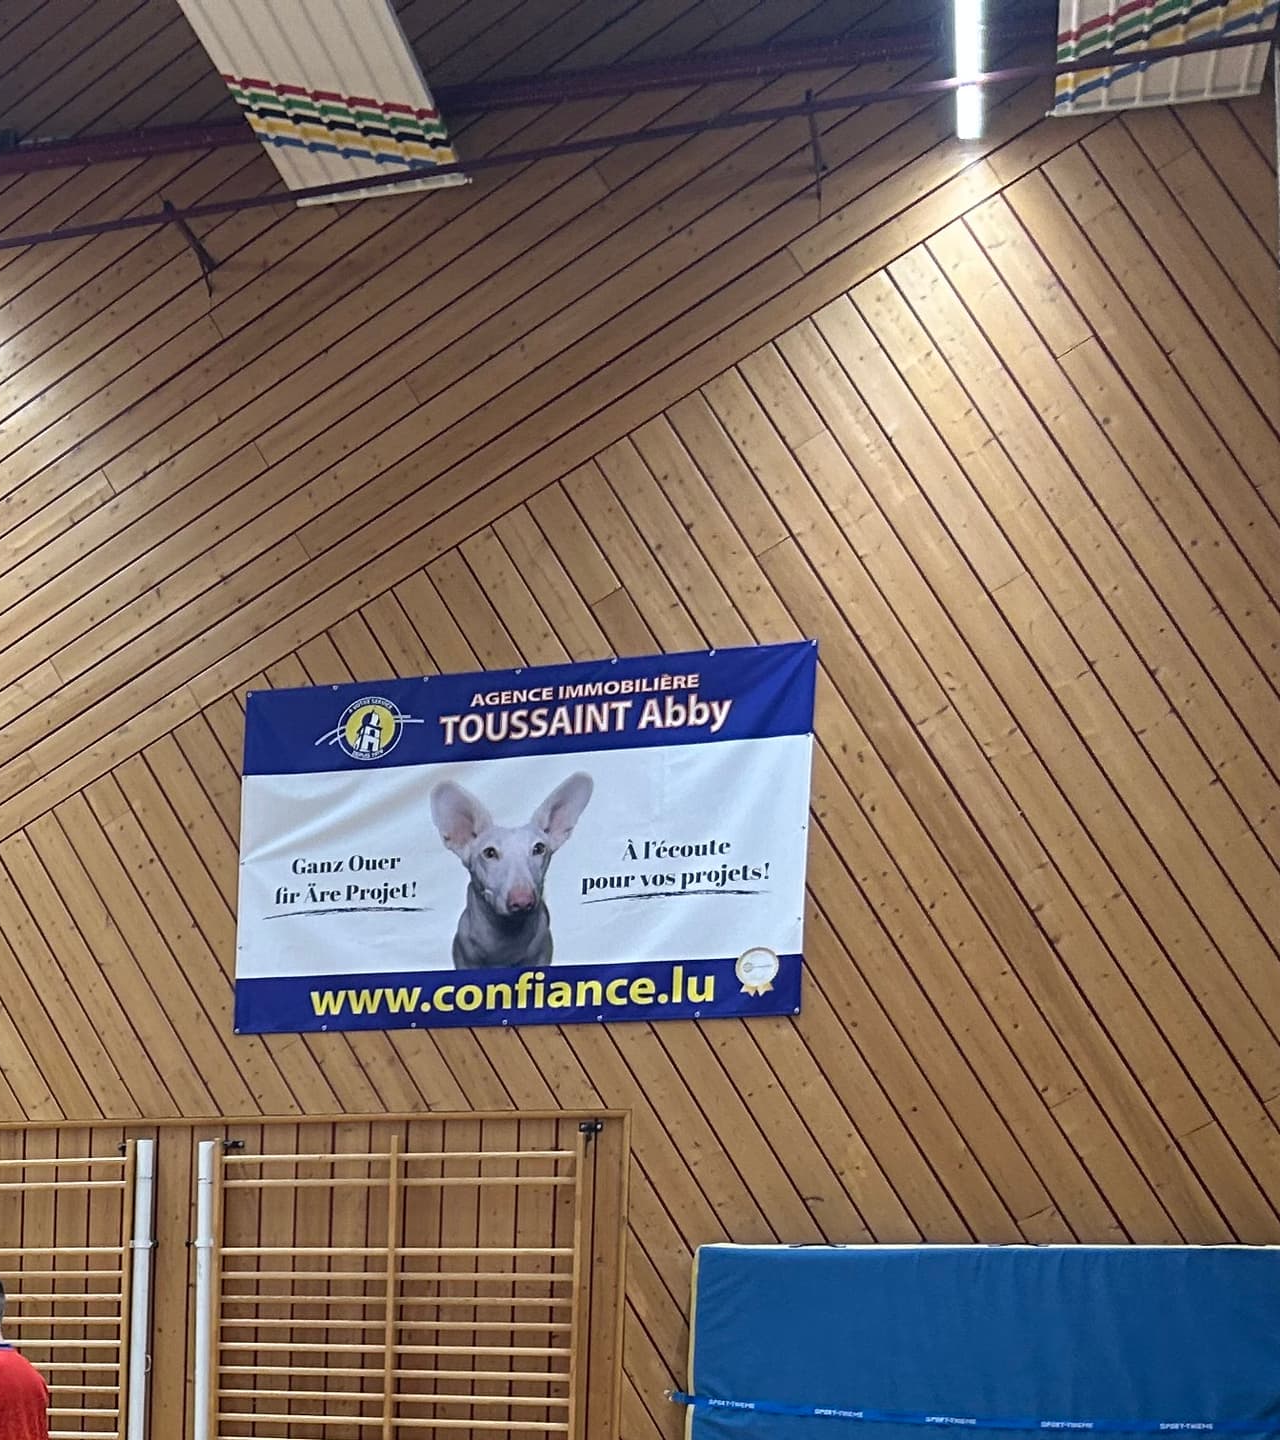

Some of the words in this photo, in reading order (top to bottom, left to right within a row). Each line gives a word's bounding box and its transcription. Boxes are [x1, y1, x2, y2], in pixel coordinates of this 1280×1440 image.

[470, 688, 553, 707] AGENCE
[558, 674, 700, 700] IMMOBILIÈRE
[439, 700, 633, 745] TOUSSAINT
[638, 693, 733, 733] Abby
[292, 858, 344, 875] Ganz
[348, 855, 401, 872] Ouer
[621, 839, 638, 861] À
[275, 886, 301, 904] fir
[304, 883, 341, 903] Äre
[345, 881, 417, 905] Projet!
[581, 873, 636, 895] pour
[640, 872, 676, 887] vos
[680, 862, 771, 890] projets!
[310, 965, 715, 1017] www.confiance.lu
